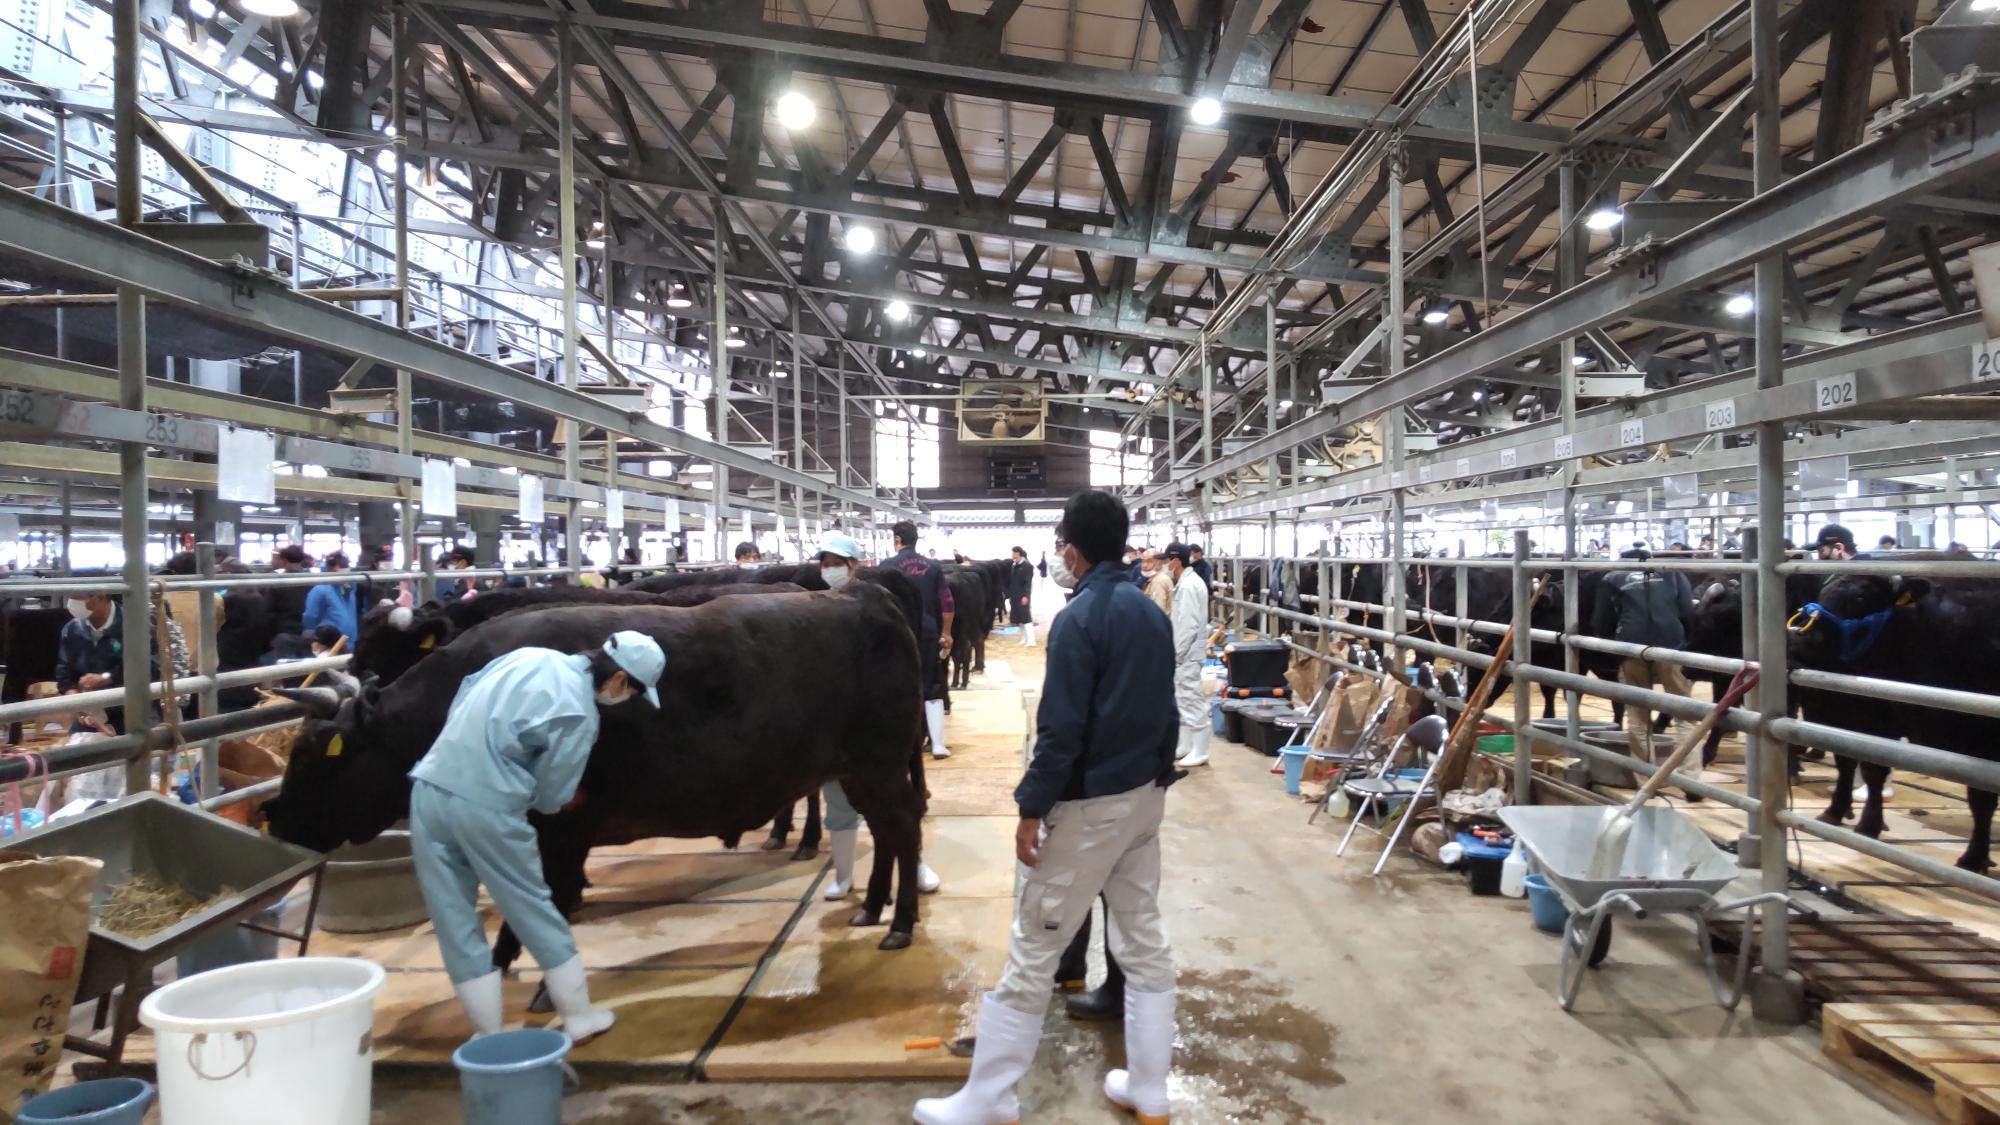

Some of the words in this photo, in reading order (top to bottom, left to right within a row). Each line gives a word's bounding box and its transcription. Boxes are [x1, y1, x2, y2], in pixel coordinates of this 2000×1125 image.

[1821, 382, 1852, 406] 202
[1709, 406, 1732, 427] 203
[146, 415, 177, 443] 253
[1623, 426, 1641, 444] 204
